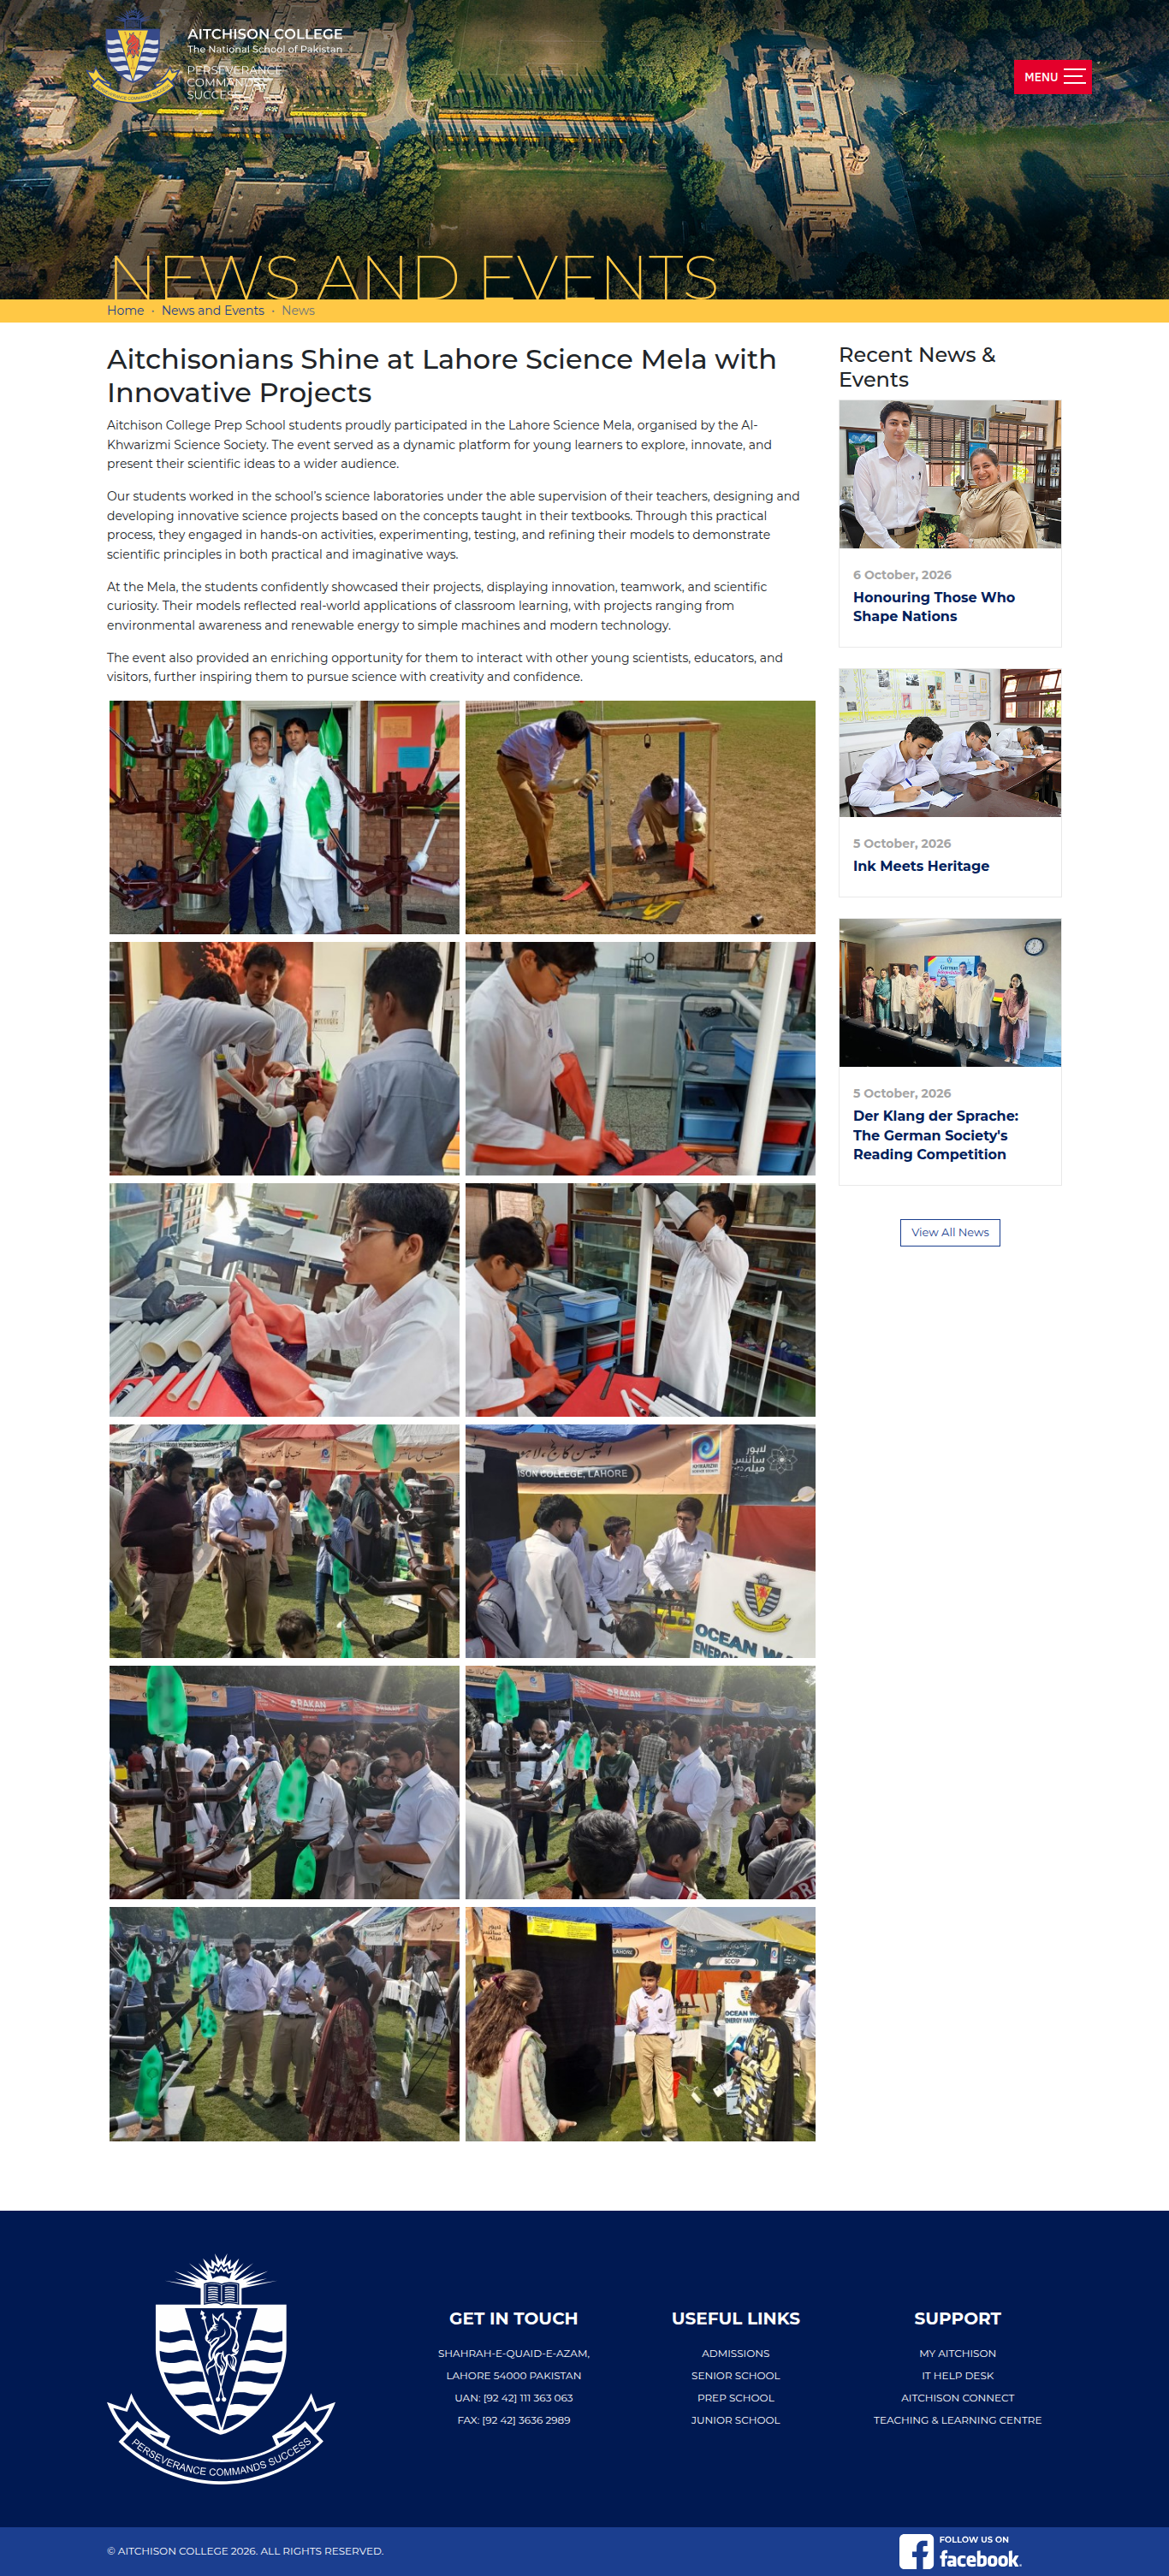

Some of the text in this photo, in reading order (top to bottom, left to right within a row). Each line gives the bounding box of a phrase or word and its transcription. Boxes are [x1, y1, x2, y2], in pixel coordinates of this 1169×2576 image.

[187, 28, 343, 40] AITCHISON COLLEGE
[187, 44, 342, 54] The National School of Pakistan
[187, 65, 282, 75] PERSEVERANCE
[187, 78, 261, 87] COMMANDS
[1024, 72, 1059, 82] MENU
[114, 255, 717, 300] NEWS AND EVENTS
[107, 305, 145, 316] Home
[162, 305, 264, 316] News and Events
[282, 305, 316, 316] News
[107, 348, 776, 370] Aitchisonians Shine at Lahore Science Mela with
[840, 347, 996, 363] Recent News &
[840, 372, 909, 388] Events
[108, 383, 372, 408] Innovative Projects
[108, 459, 154, 471] present
[157, 459, 185, 469] their
[188, 459, 241, 469] scientific
[245, 459, 276, 469] ideas
[278, 459, 291, 469] to
[304, 459, 338, 469] wider
[341, 459, 400, 469] audience.
[853, 570, 952, 582] 6 October, 2026
[854, 592, 1016, 606] Honouring Those Who
[854, 611, 958, 625] Shape Nations
[853, 838, 952, 850] 5 October, 2026
[854, 861, 990, 874] Ink Meets Heritage
[853, 1088, 952, 1100] 5 October, 2026
[854, 1110, 1019, 1124] Der Klang der Sprache:
[853, 1130, 1008, 1144] The German Society's
[854, 1149, 1006, 1163] Reading Competition
[911, 1228, 990, 1237] View All News
[588, 1468, 628, 1477] LAHORE
[695, 1623, 758, 1658] OCEAN
[614, 1689, 642, 1699] RAKAN
[297, 1698, 327, 1709] RAKAN
[449, 2312, 578, 2325] GET IN TOUCH
[673, 2312, 801, 2325] USEFUL LINKS
[914, 2312, 1002, 2325] SUPPORT
[438, 2350, 590, 2360] SHAHRAH-E-QUAID-E-AZAM,
[484, 2394, 499, 2404] [92
[501, 2394, 517, 2404] 42]
[132, 2437, 312, 2477] PERSEVERANCE COMMANDS SUCCESS
[107, 2546, 116, 2555] ©
